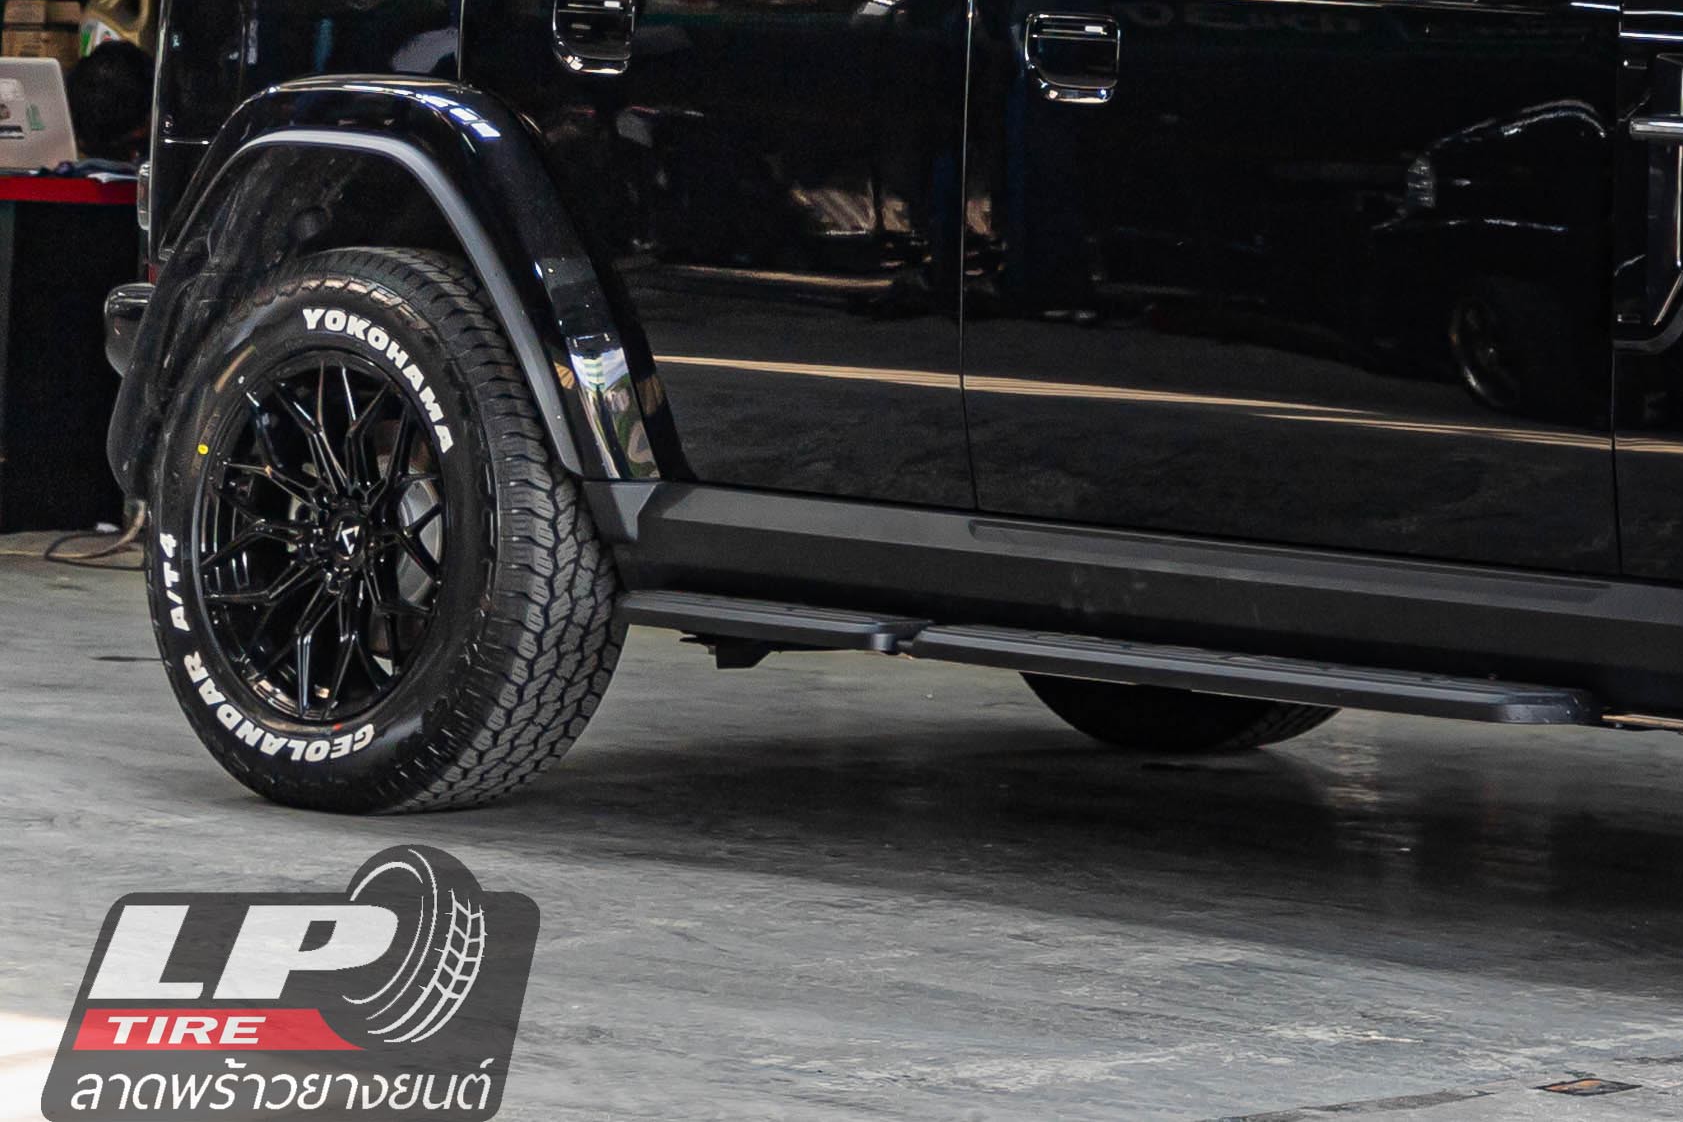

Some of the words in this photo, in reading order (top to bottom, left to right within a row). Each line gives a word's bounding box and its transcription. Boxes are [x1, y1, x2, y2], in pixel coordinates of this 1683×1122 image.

[302, 307, 454, 455] YOKOHAMA
[158, 531, 192, 634] A/T4
[183, 650, 376, 764] GEOLANDAR
